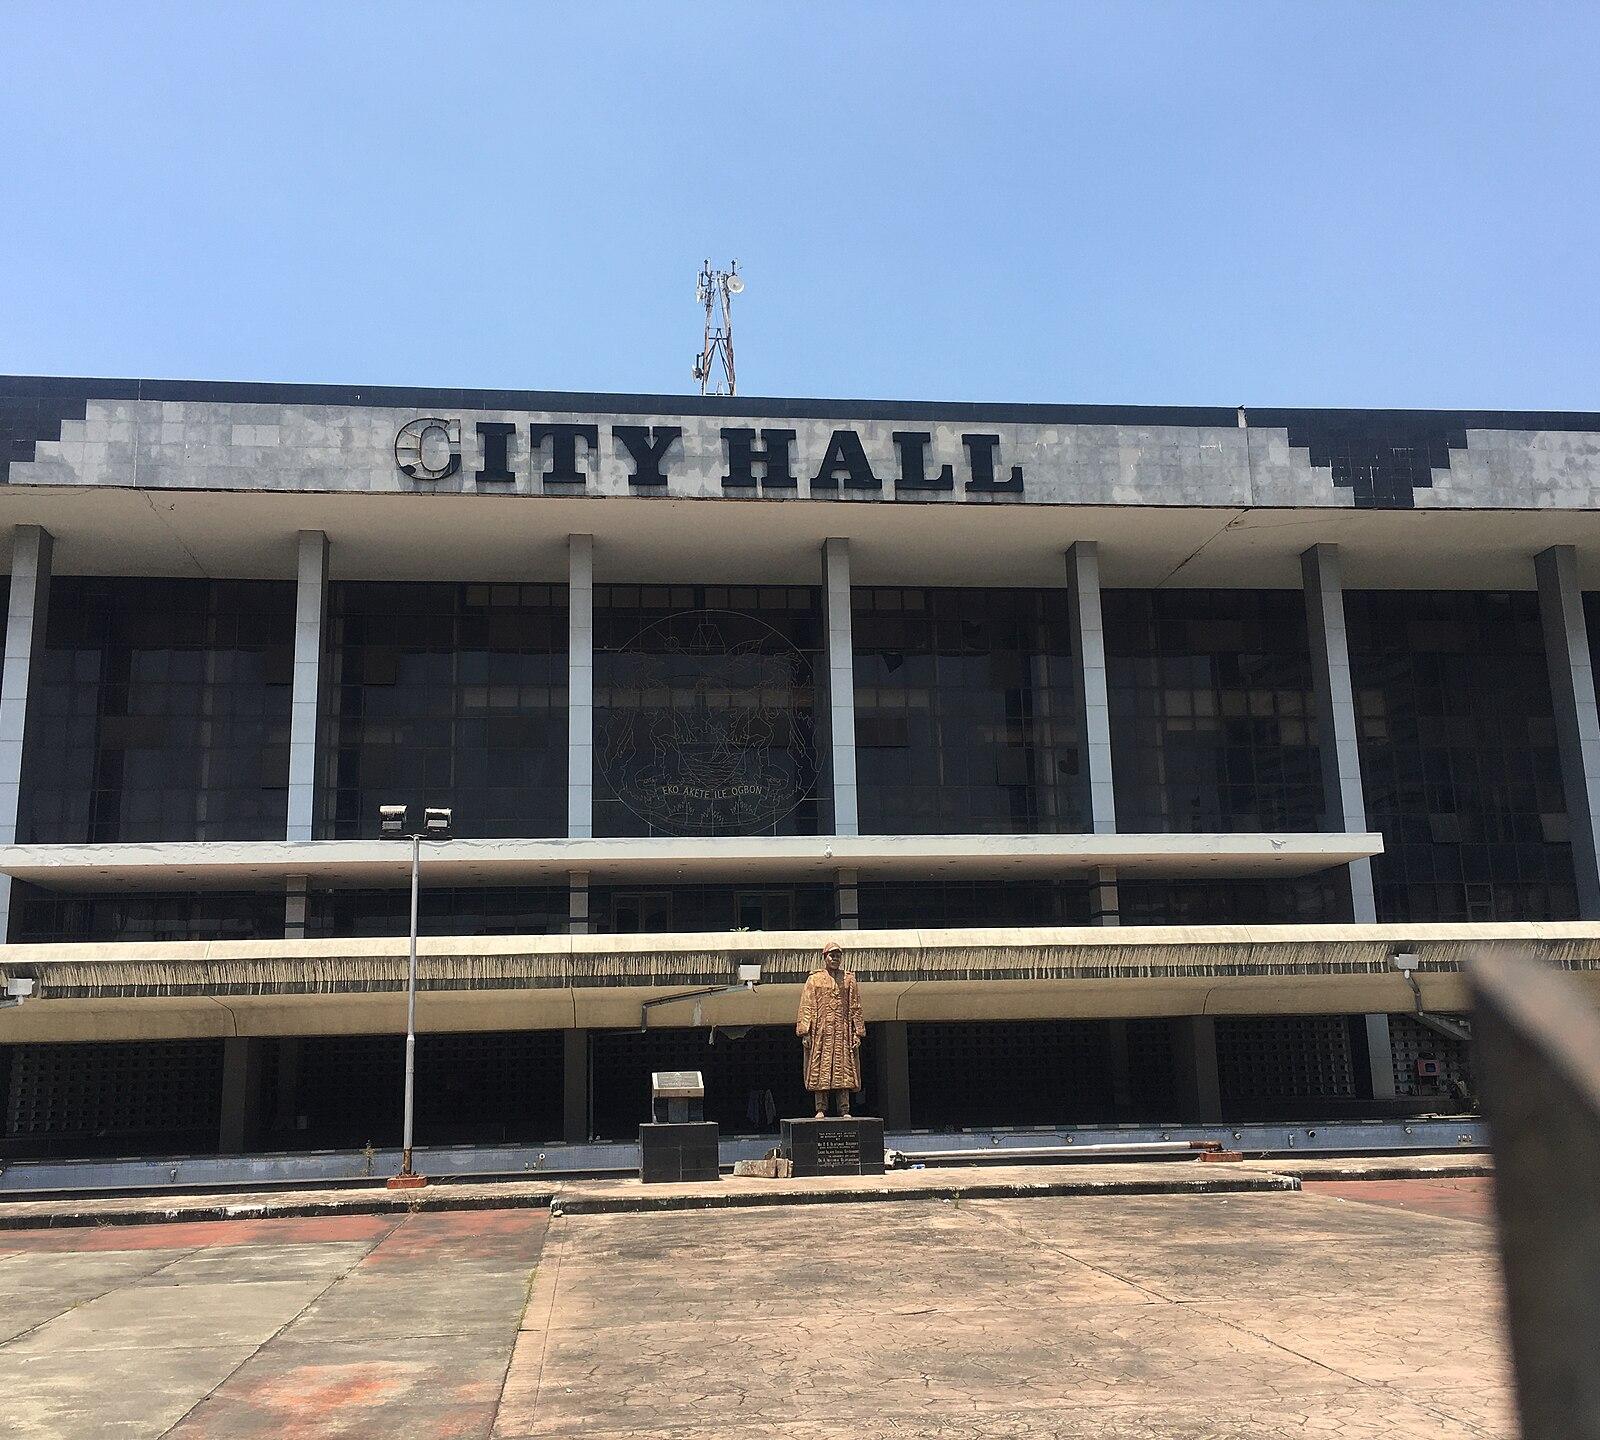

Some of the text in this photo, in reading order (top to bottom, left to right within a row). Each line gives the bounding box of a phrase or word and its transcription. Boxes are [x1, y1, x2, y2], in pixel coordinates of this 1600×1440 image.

[395, 417, 1024, 493] CITY HALL
[662, 785, 763, 799] EKO AKETE ILE OGBON
